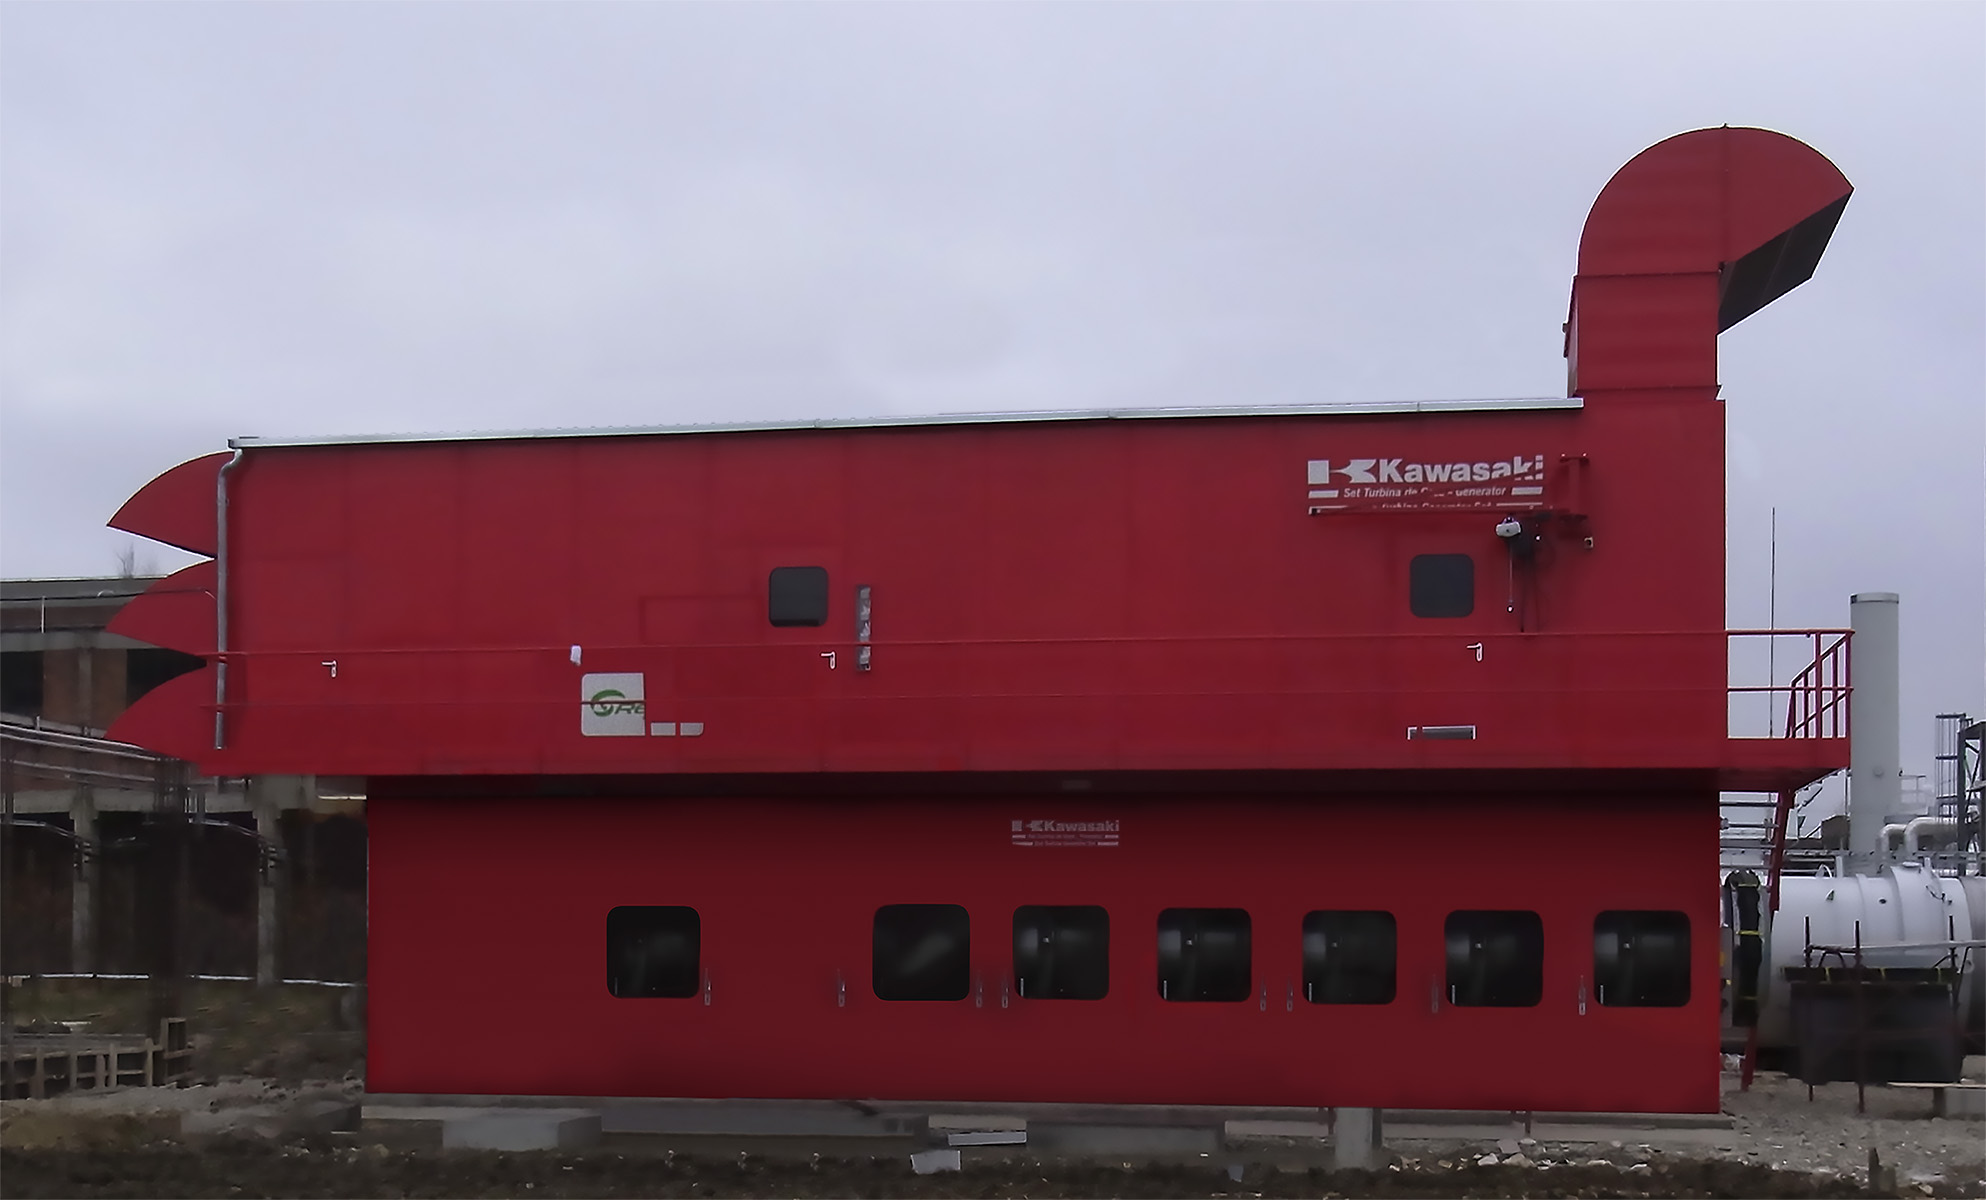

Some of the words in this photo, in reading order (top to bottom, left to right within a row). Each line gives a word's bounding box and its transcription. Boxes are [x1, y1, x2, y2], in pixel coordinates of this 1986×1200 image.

[1379, 455, 1543, 483] Kawasaki
[1343, 487, 1361, 498] Set
[1364, 486, 1401, 498] Turbina
[1044, 820, 1119, 832] Kawasaki
